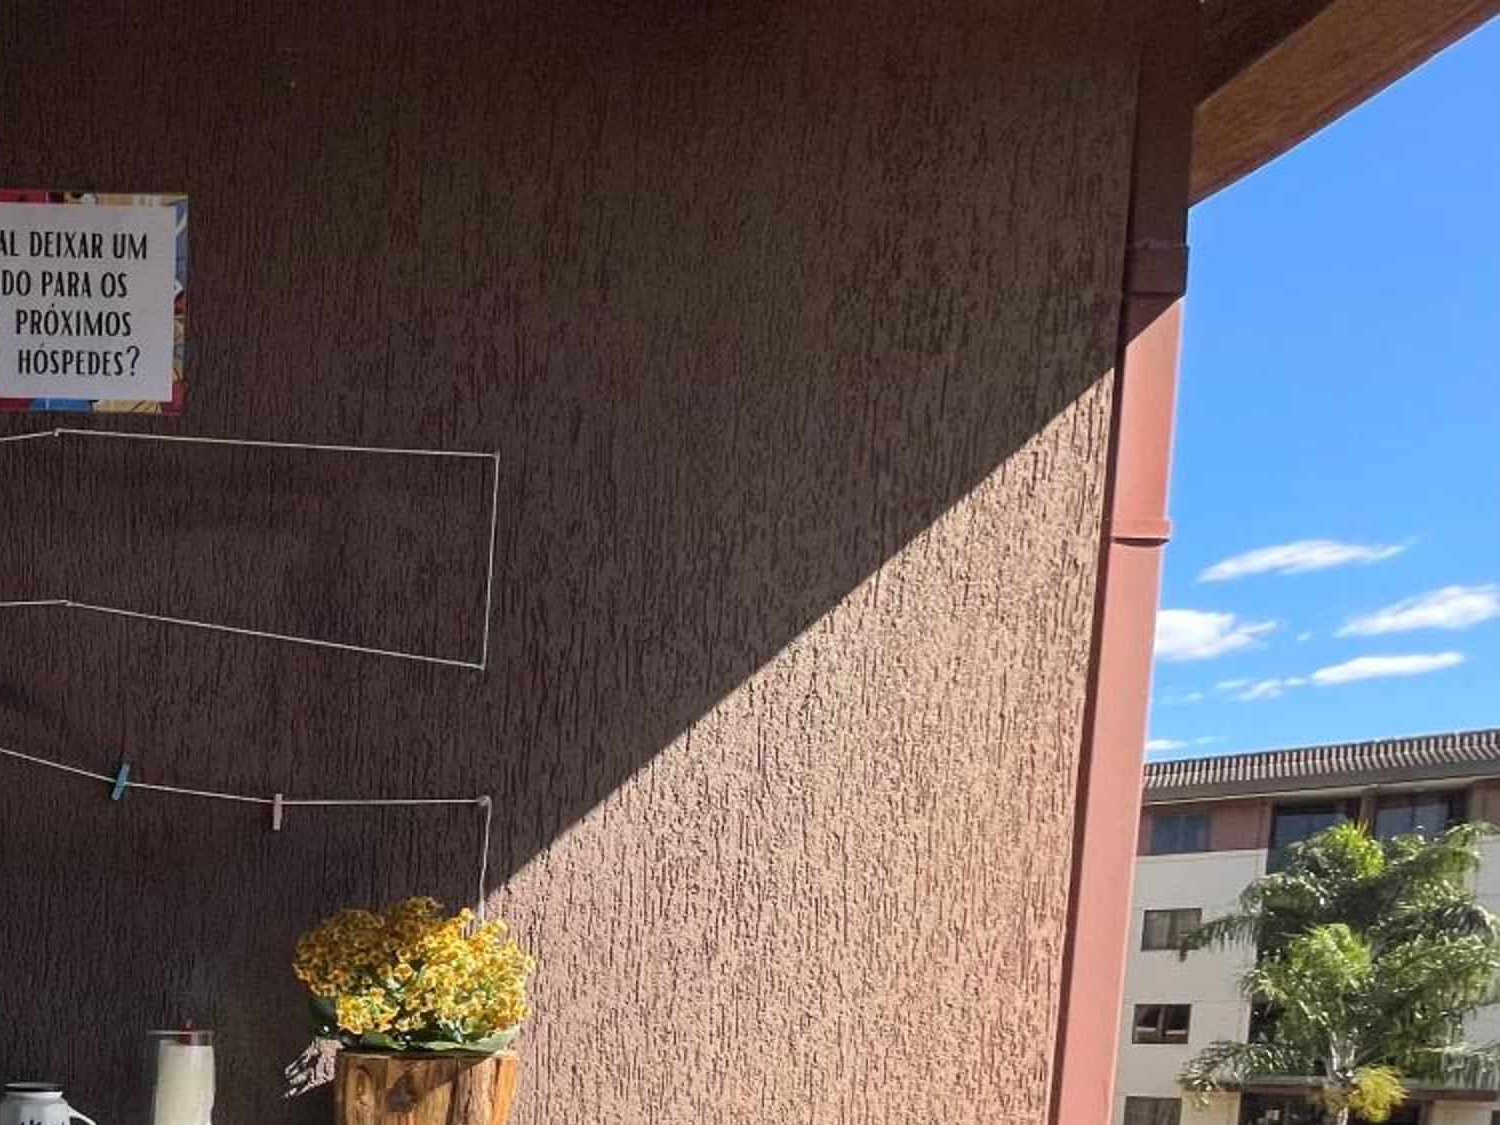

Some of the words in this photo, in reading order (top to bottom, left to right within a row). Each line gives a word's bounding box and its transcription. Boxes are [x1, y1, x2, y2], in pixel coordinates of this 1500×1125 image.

[30, 230, 104, 259] DEIXAR
[113, 232, 148, 260] UM
[41, 271, 92, 298] PARA
[101, 271, 128, 299] OS
[15, 303, 133, 337] PRÓXIMOS
[17, 342, 141, 378] HÓSPEDES?
